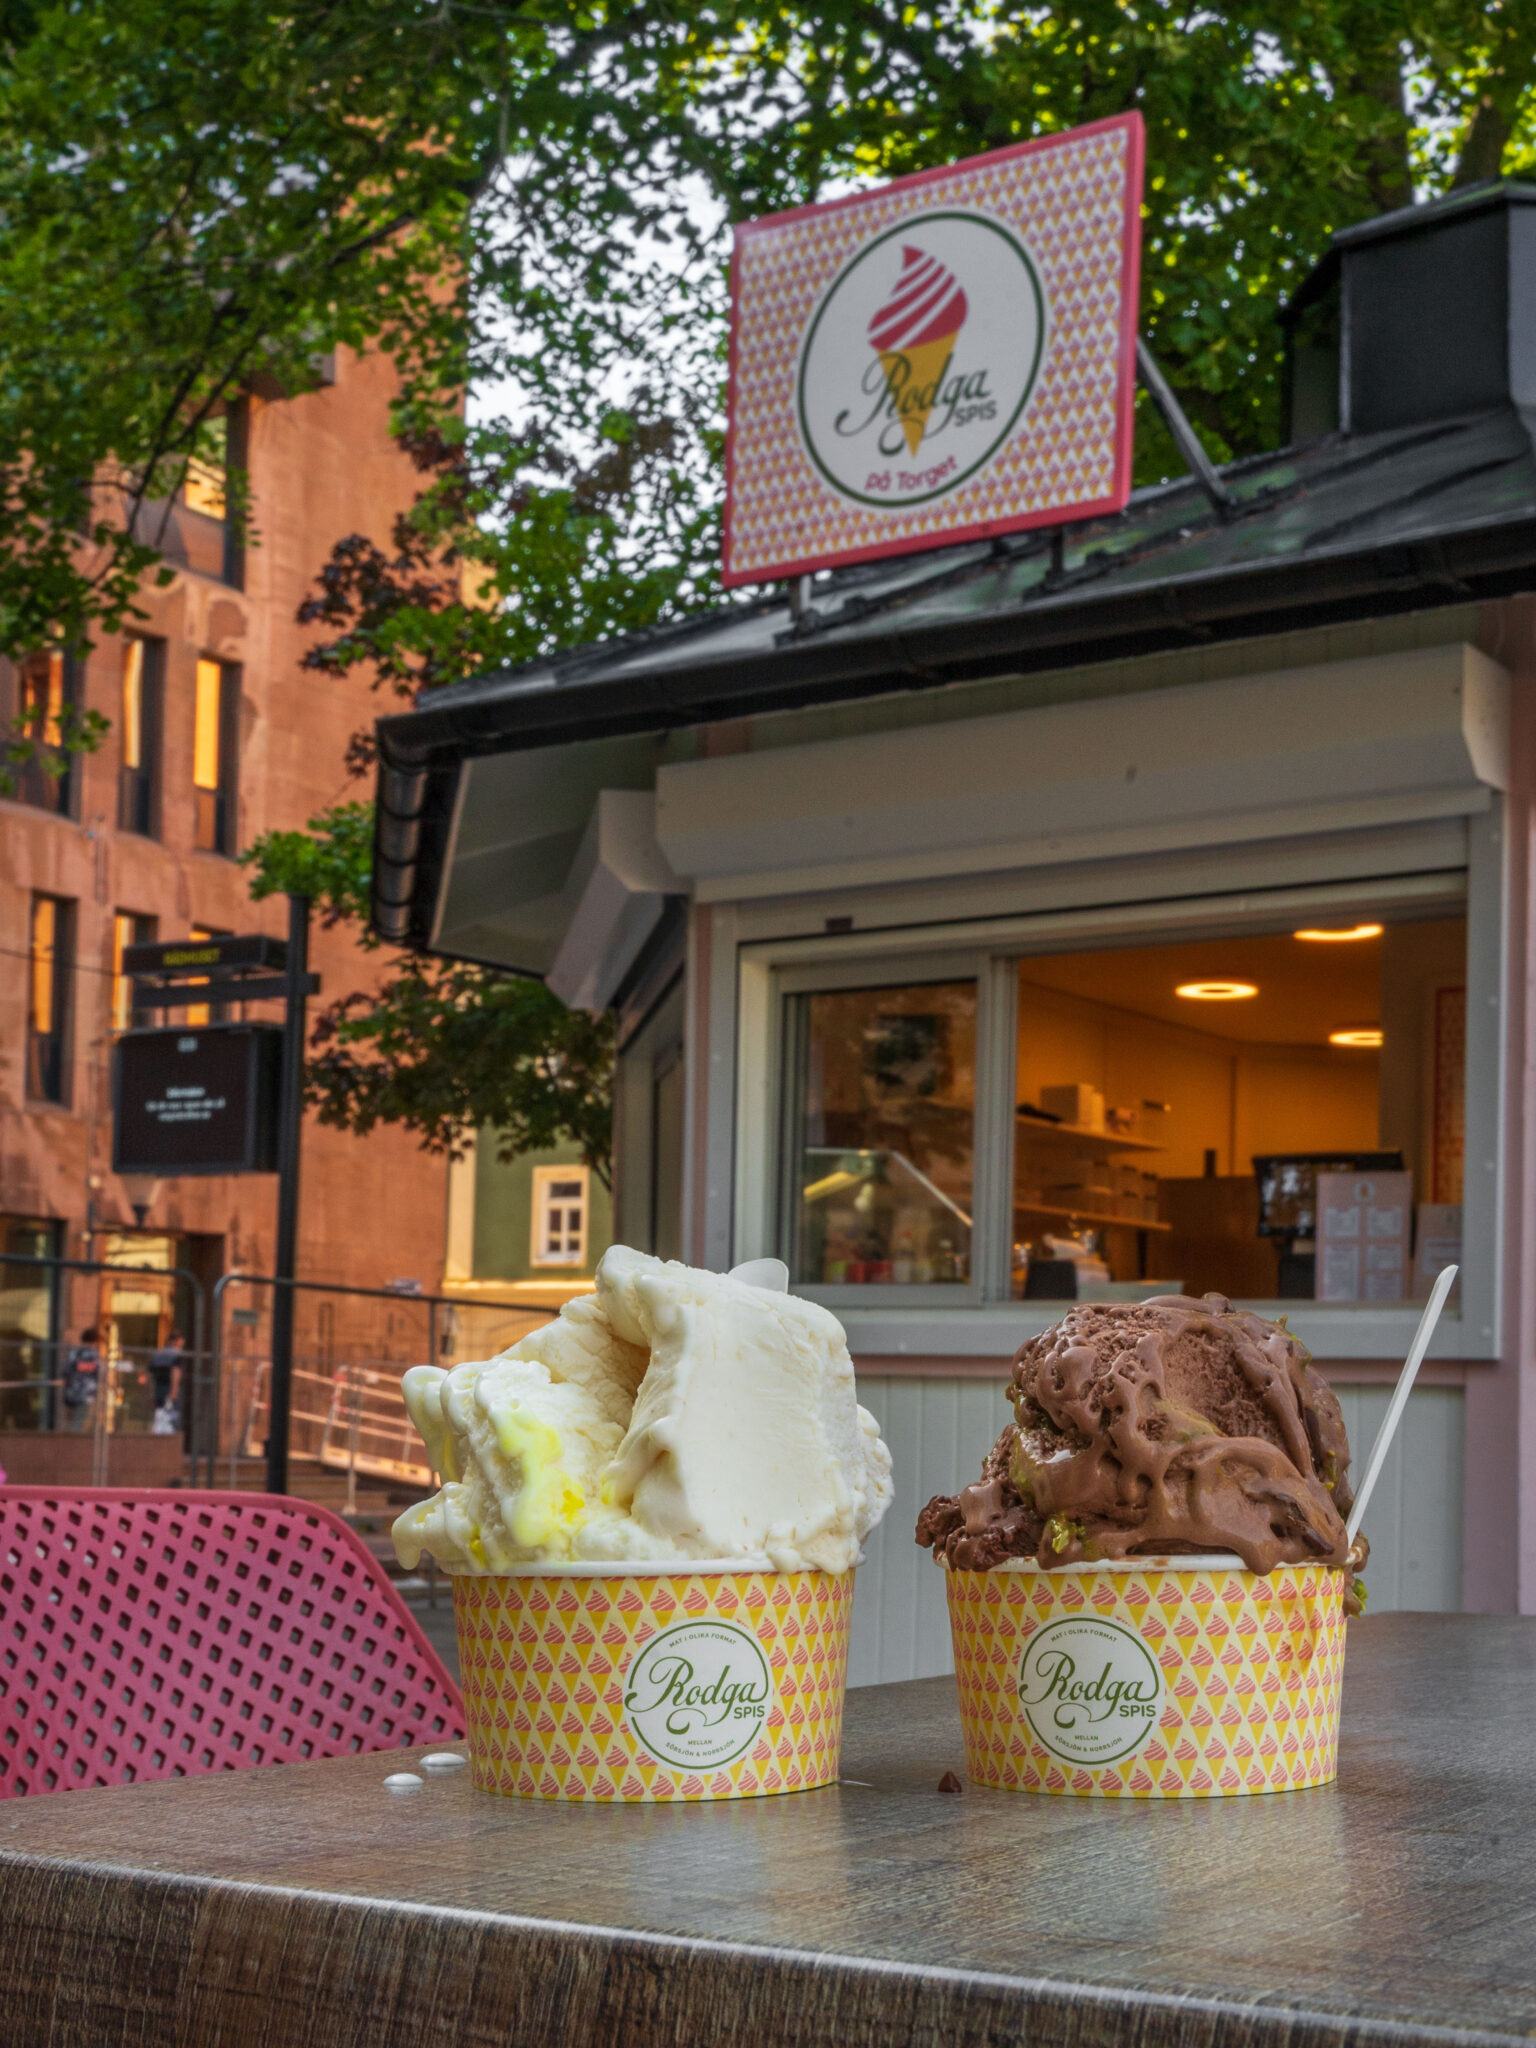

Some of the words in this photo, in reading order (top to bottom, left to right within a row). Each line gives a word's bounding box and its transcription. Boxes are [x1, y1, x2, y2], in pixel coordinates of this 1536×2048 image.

[834, 351, 993, 457] Rodga
[954, 400, 997, 427] SPIS
[898, 454, 957, 490] Torget
[669, 1637, 682, 1648] MAT
[688, 1632, 709, 1640] OLIKA
[711, 1633, 737, 1645] FORMAT
[1050, 1632, 1063, 1642] MAT
[1090, 1629, 1117, 1642] FORMAT
[624, 1656, 764, 1735] Rodga
[1018, 1650, 1155, 1729] Rodga
[733, 1705, 765, 1719] SPIS
[1119, 1704, 1156, 1718] SPIS
